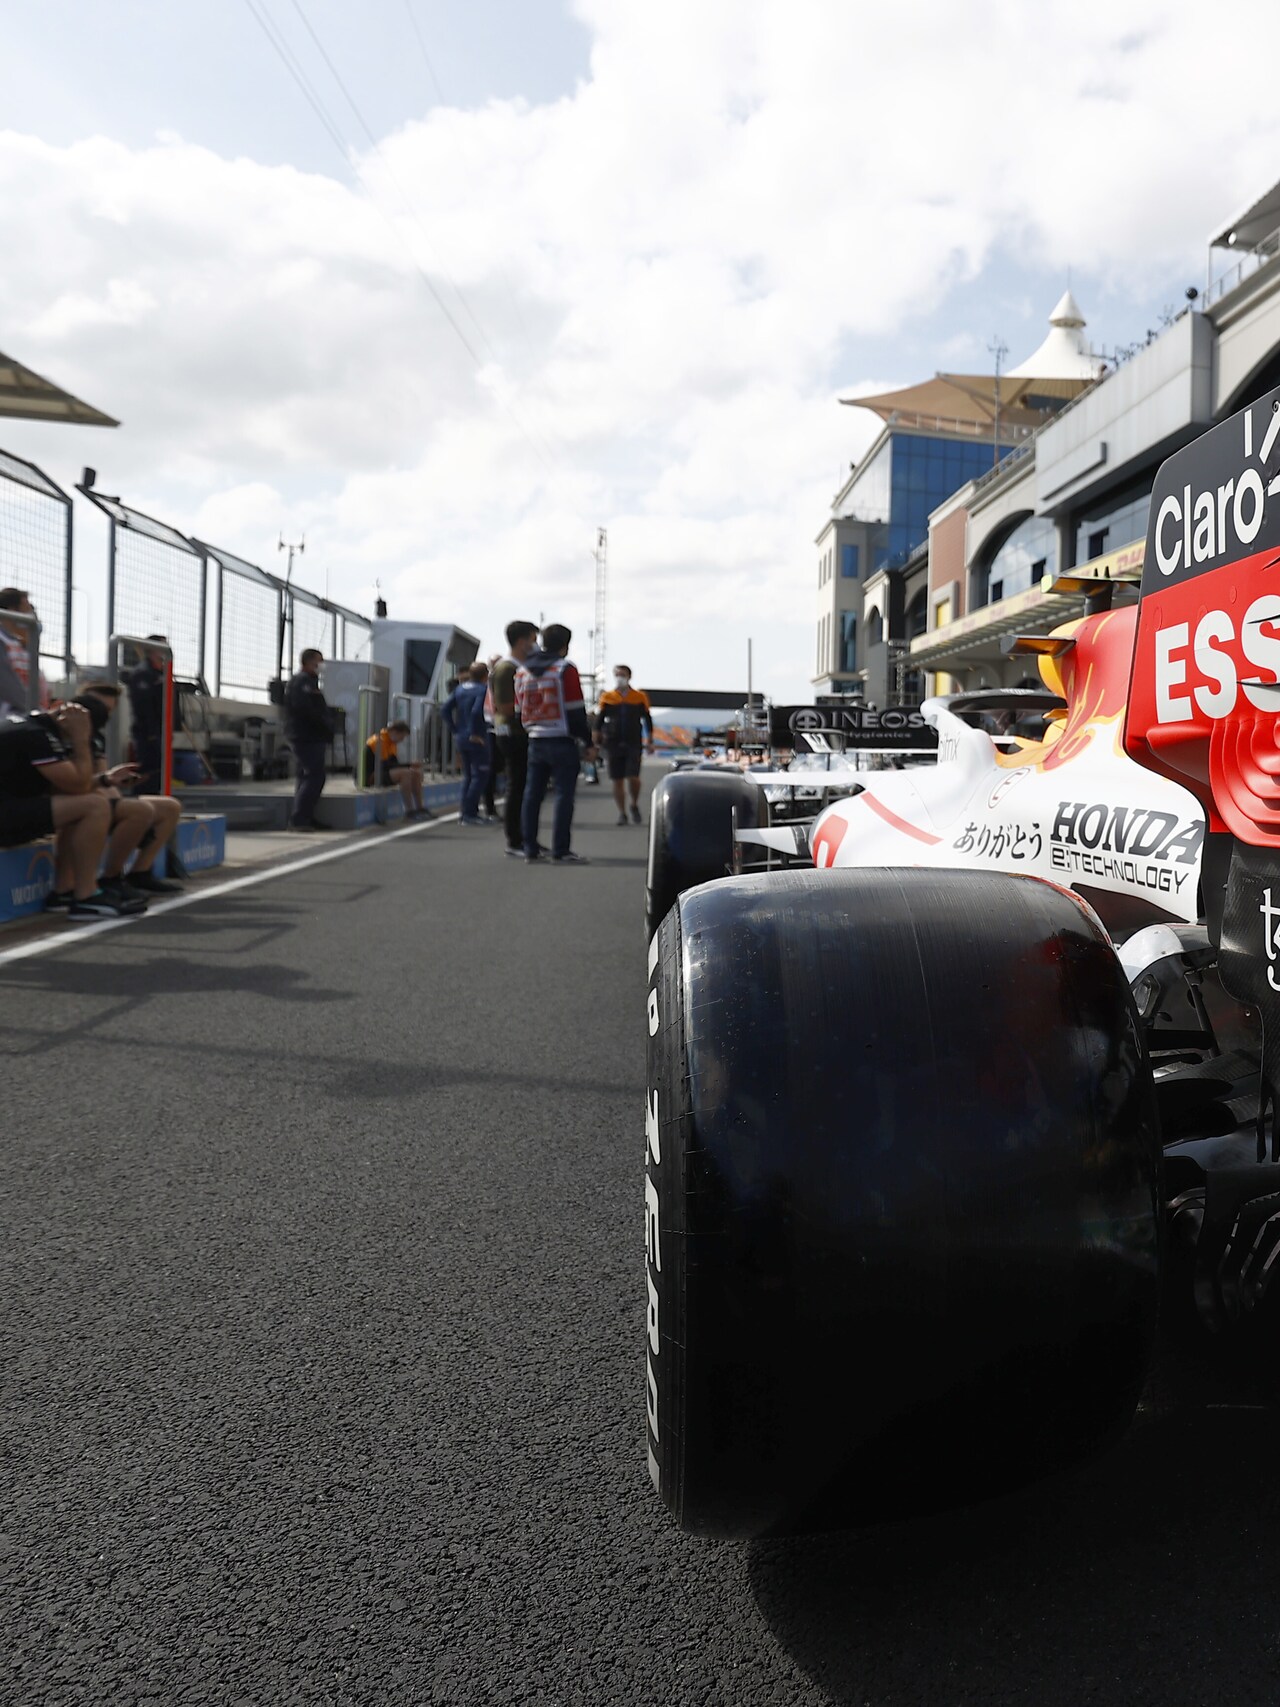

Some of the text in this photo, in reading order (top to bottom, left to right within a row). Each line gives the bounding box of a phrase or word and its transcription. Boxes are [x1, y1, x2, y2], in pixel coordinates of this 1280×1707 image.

[1155, 467, 1264, 576] Claro
[831, 712, 924, 728] INEOS
[953, 821, 1042, 861] ありがとう
[1050, 801, 1207, 865] HONDA
